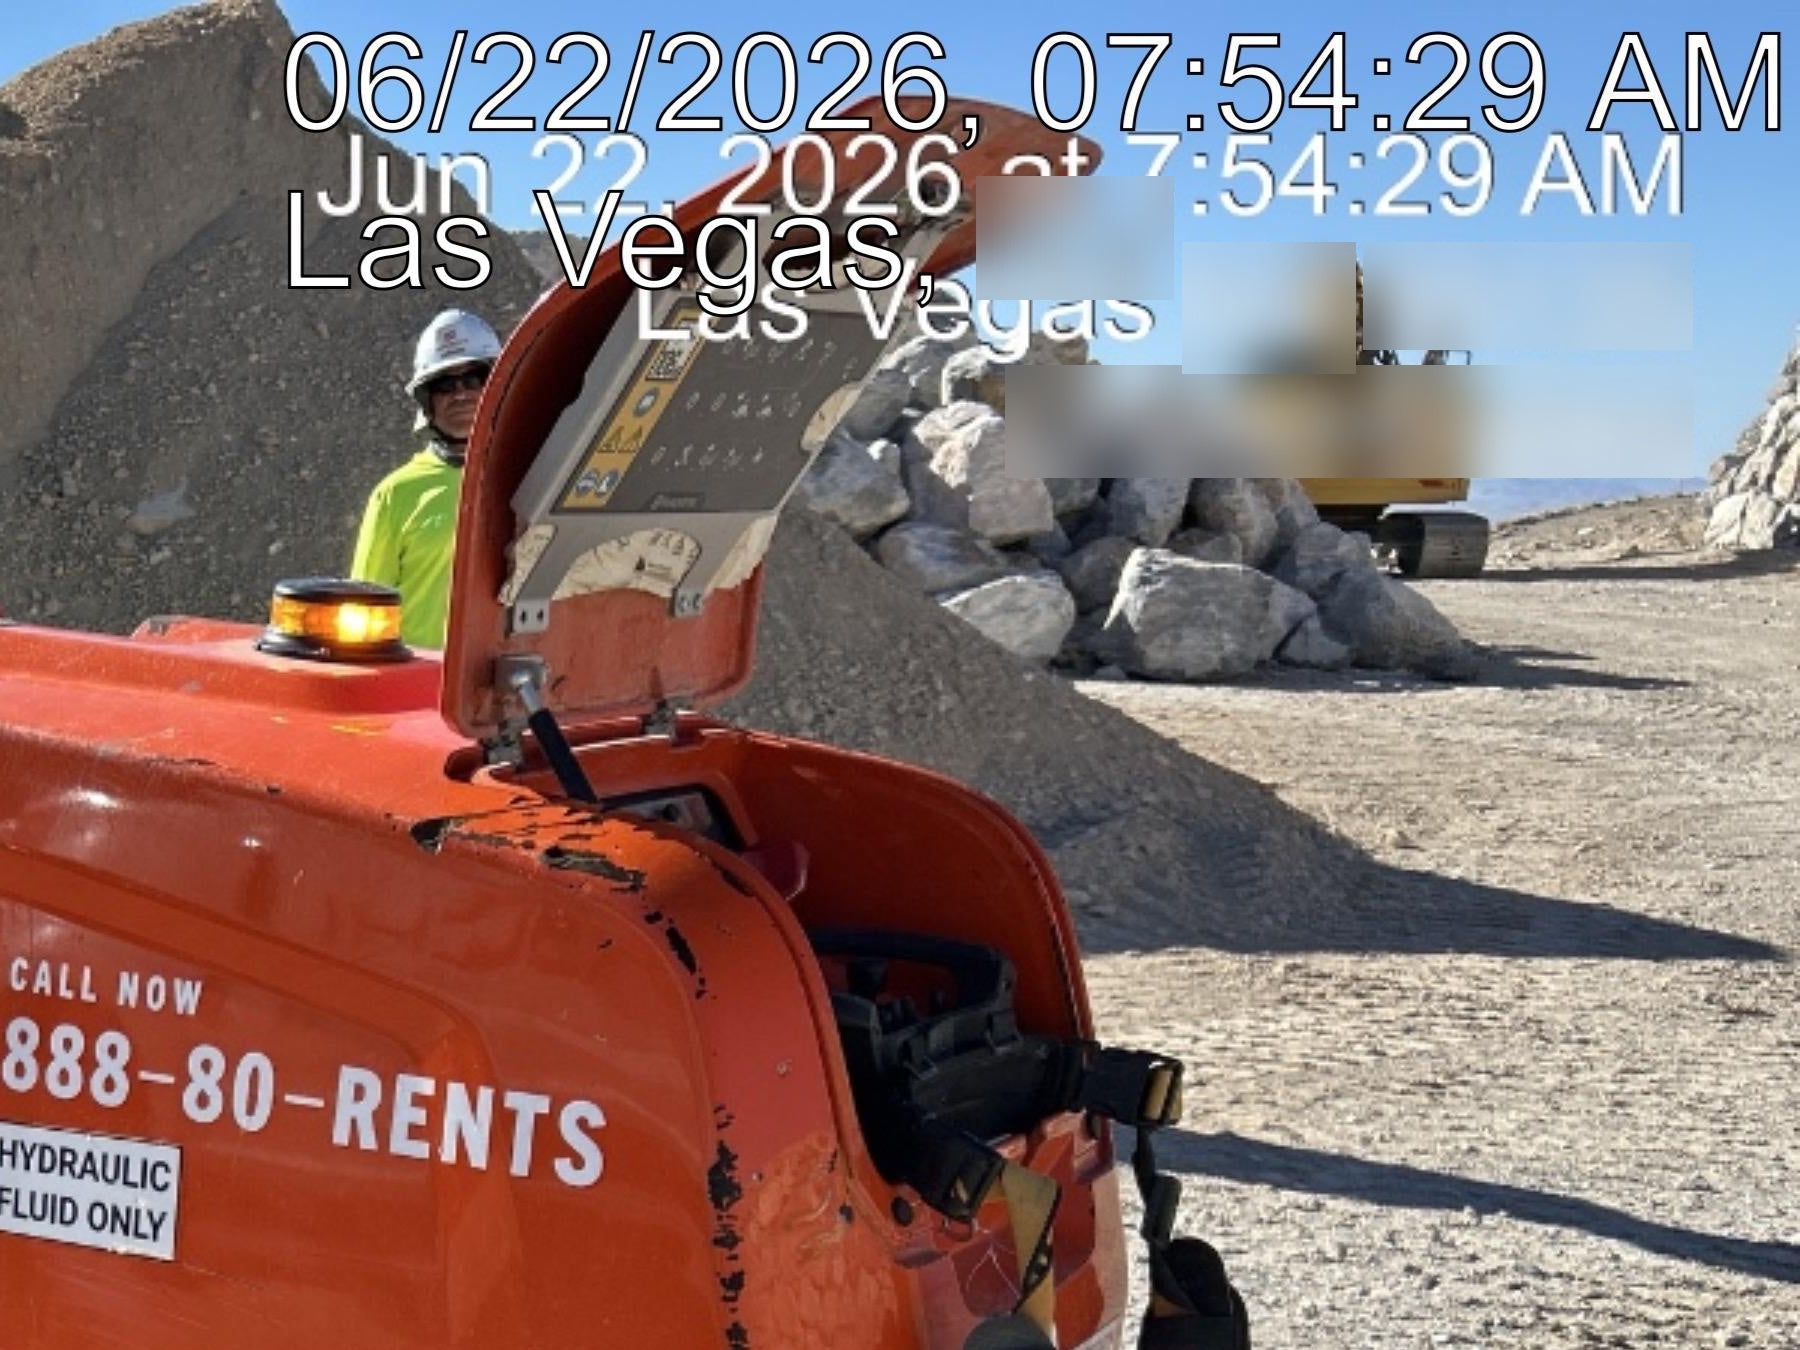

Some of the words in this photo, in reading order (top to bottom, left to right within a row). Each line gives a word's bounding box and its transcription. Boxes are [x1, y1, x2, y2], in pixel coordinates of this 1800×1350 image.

[9, 956, 98, 1004] CALL
[117, 970, 203, 1016] NOW
[1, 1016, 607, 1187] 888-80-RENTS
[86, 1200, 169, 1243] ONLY
